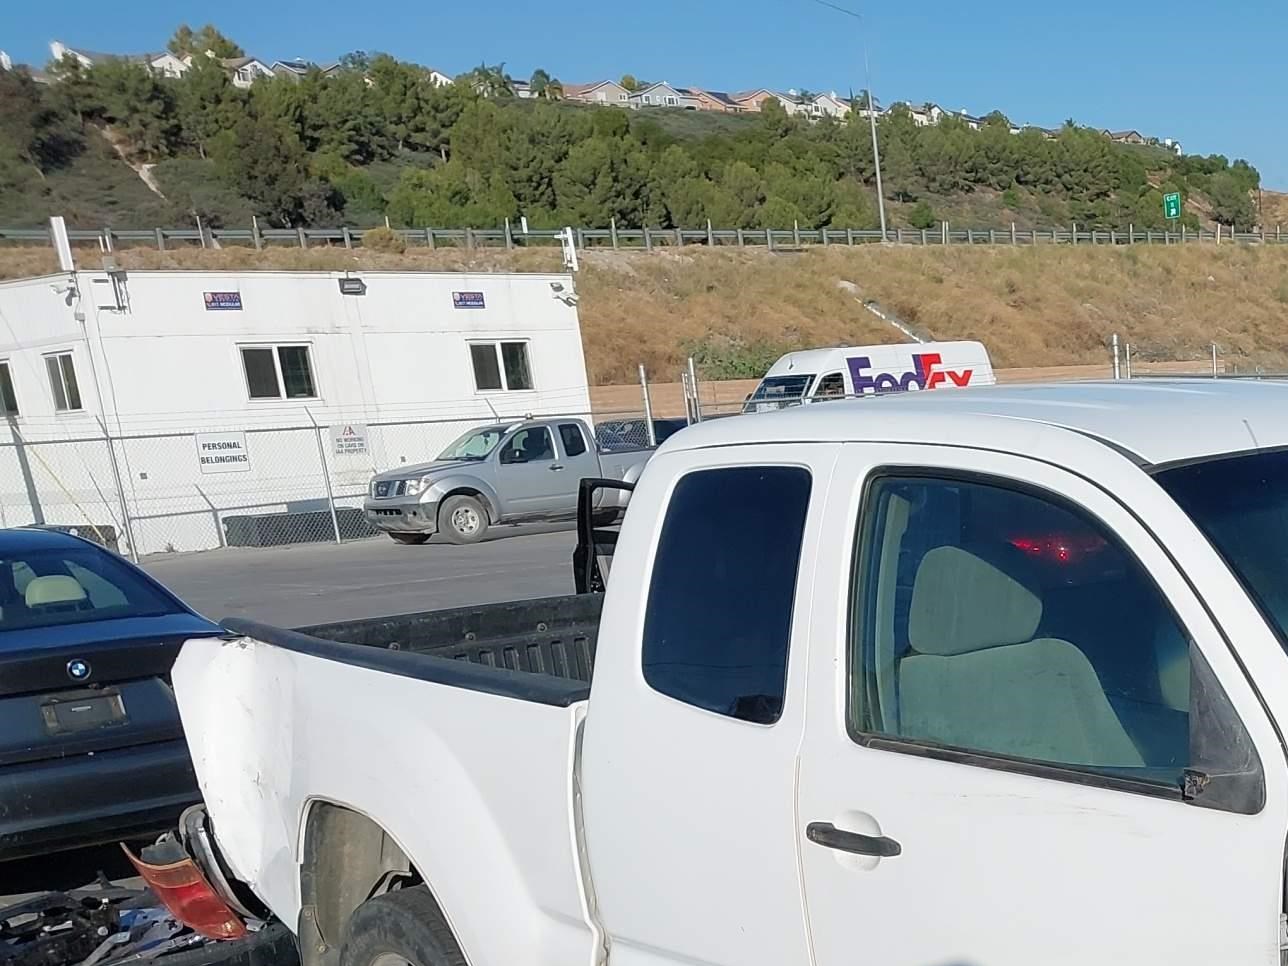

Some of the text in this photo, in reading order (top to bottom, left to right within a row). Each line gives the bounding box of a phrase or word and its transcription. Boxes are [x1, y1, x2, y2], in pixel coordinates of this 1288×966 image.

[846, 353, 973, 397] FedEx
[202, 441, 242, 451] PERSONAL
[200, 454, 248, 464] BELONGINGS
